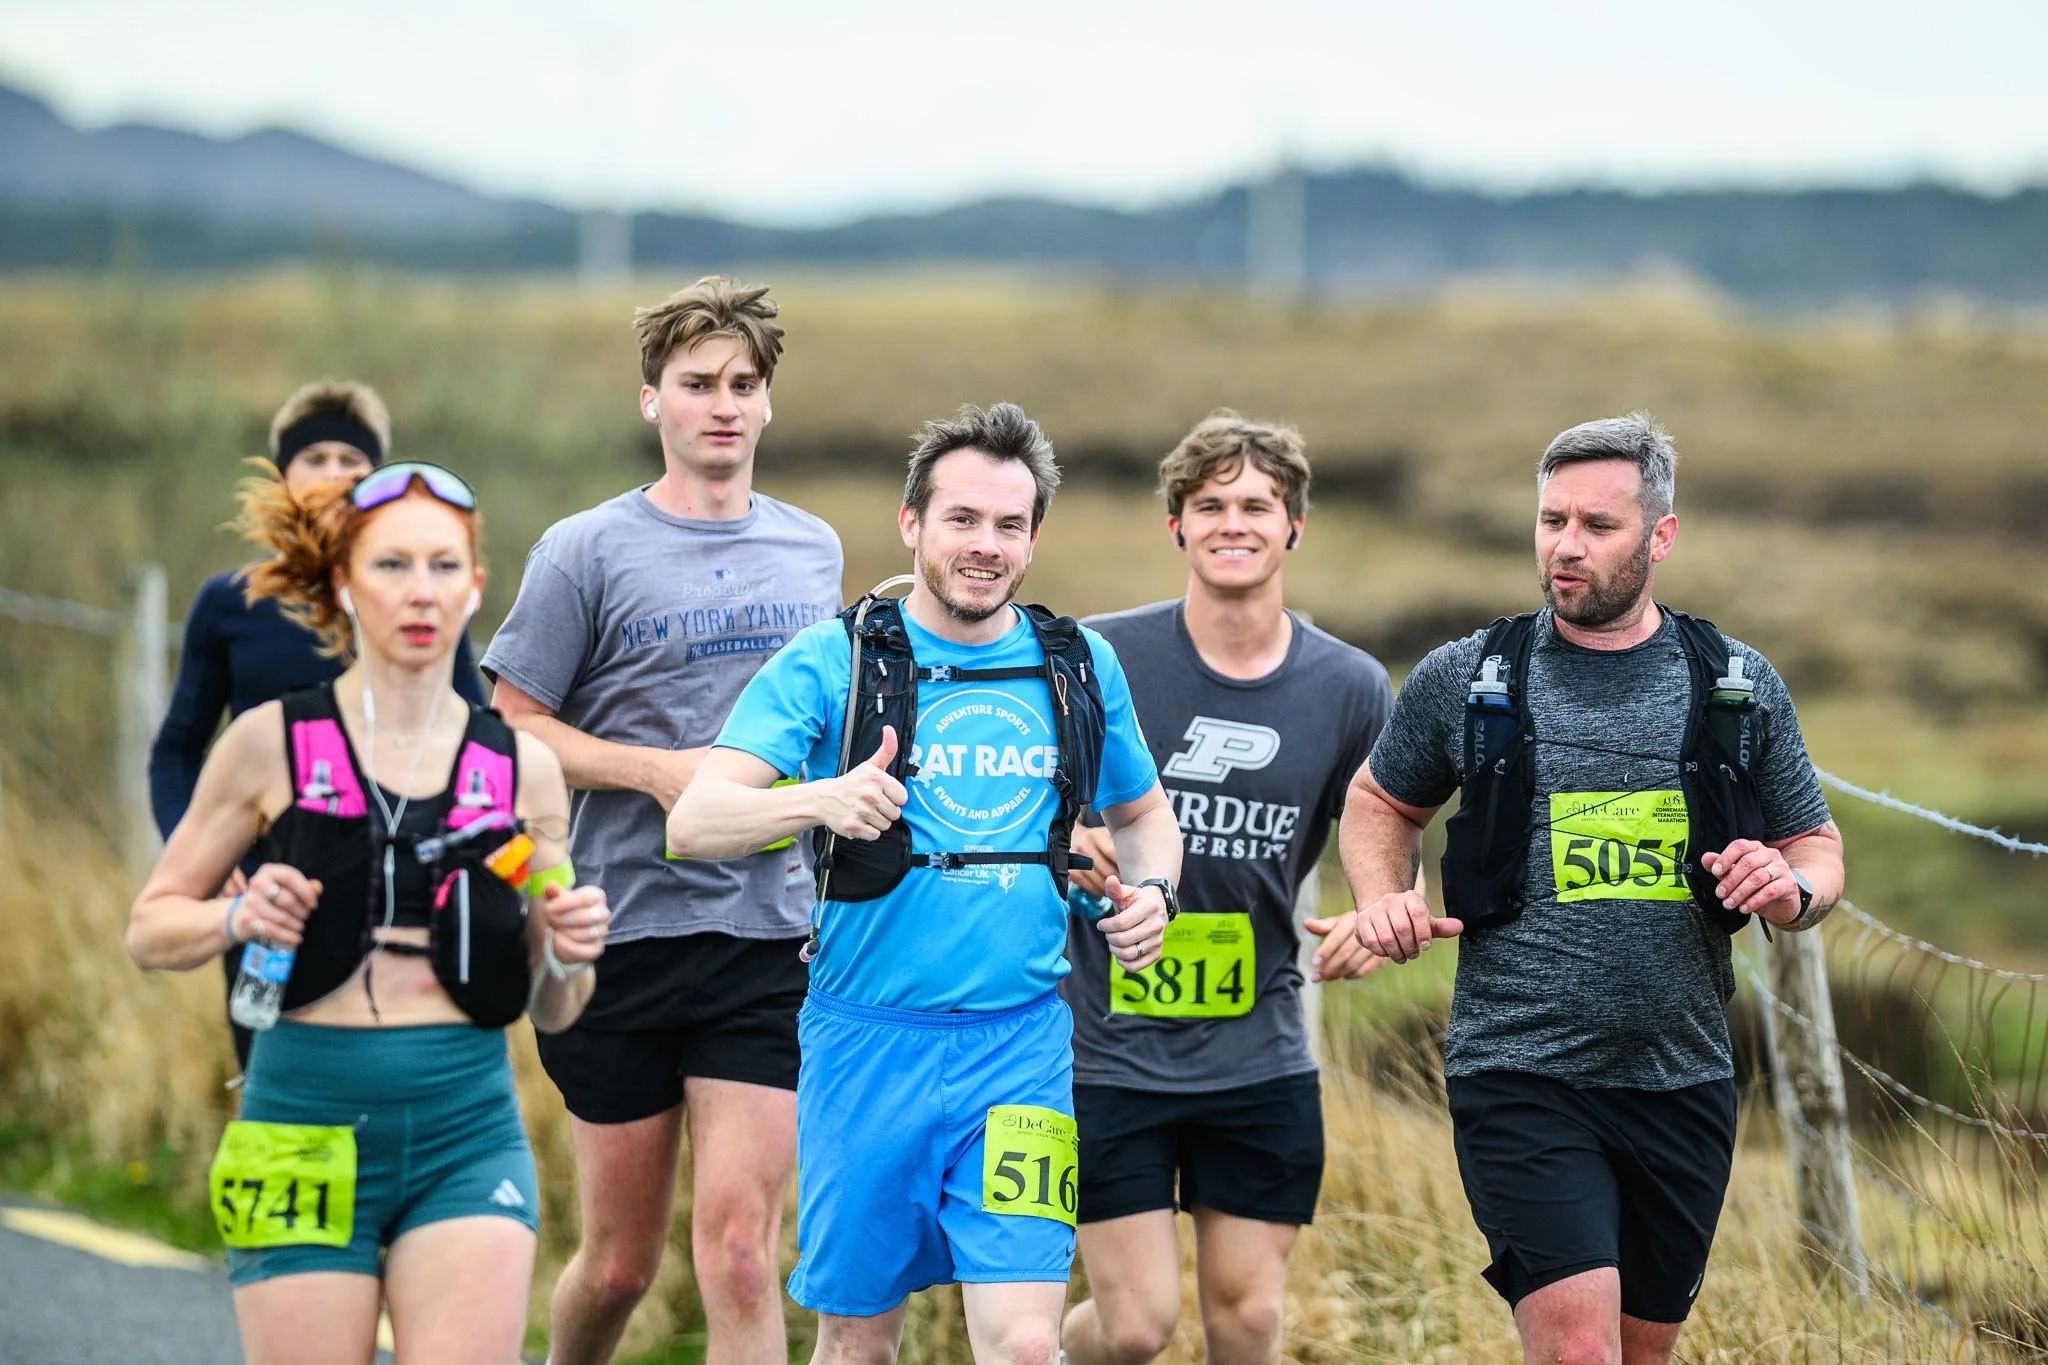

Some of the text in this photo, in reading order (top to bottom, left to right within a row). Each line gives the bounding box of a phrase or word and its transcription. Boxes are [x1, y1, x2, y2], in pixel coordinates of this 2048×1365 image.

[621, 615, 669, 648] NEW
[678, 606, 736, 637] YORK
[705, 640, 766, 654] BASEBALL
[935, 704, 1032, 736] ADVENTURE SPORTS
[975, 745, 1059, 778] RACE
[1162, 715, 1281, 784] P
[1474, 719, 1485, 766] SALO
[1740, 715, 1751, 770] SALO
[933, 785, 1031, 820] EVENTS AND APPAREL
[1166, 788, 1301, 841] RDUE
[1583, 803, 1640, 816] DeCare
[975, 869, 990, 878] UK
[1563, 838, 1688, 889] 5051
[1121, 956, 1244, 1004] 5814
[1019, 1116, 1066, 1136] DeCare
